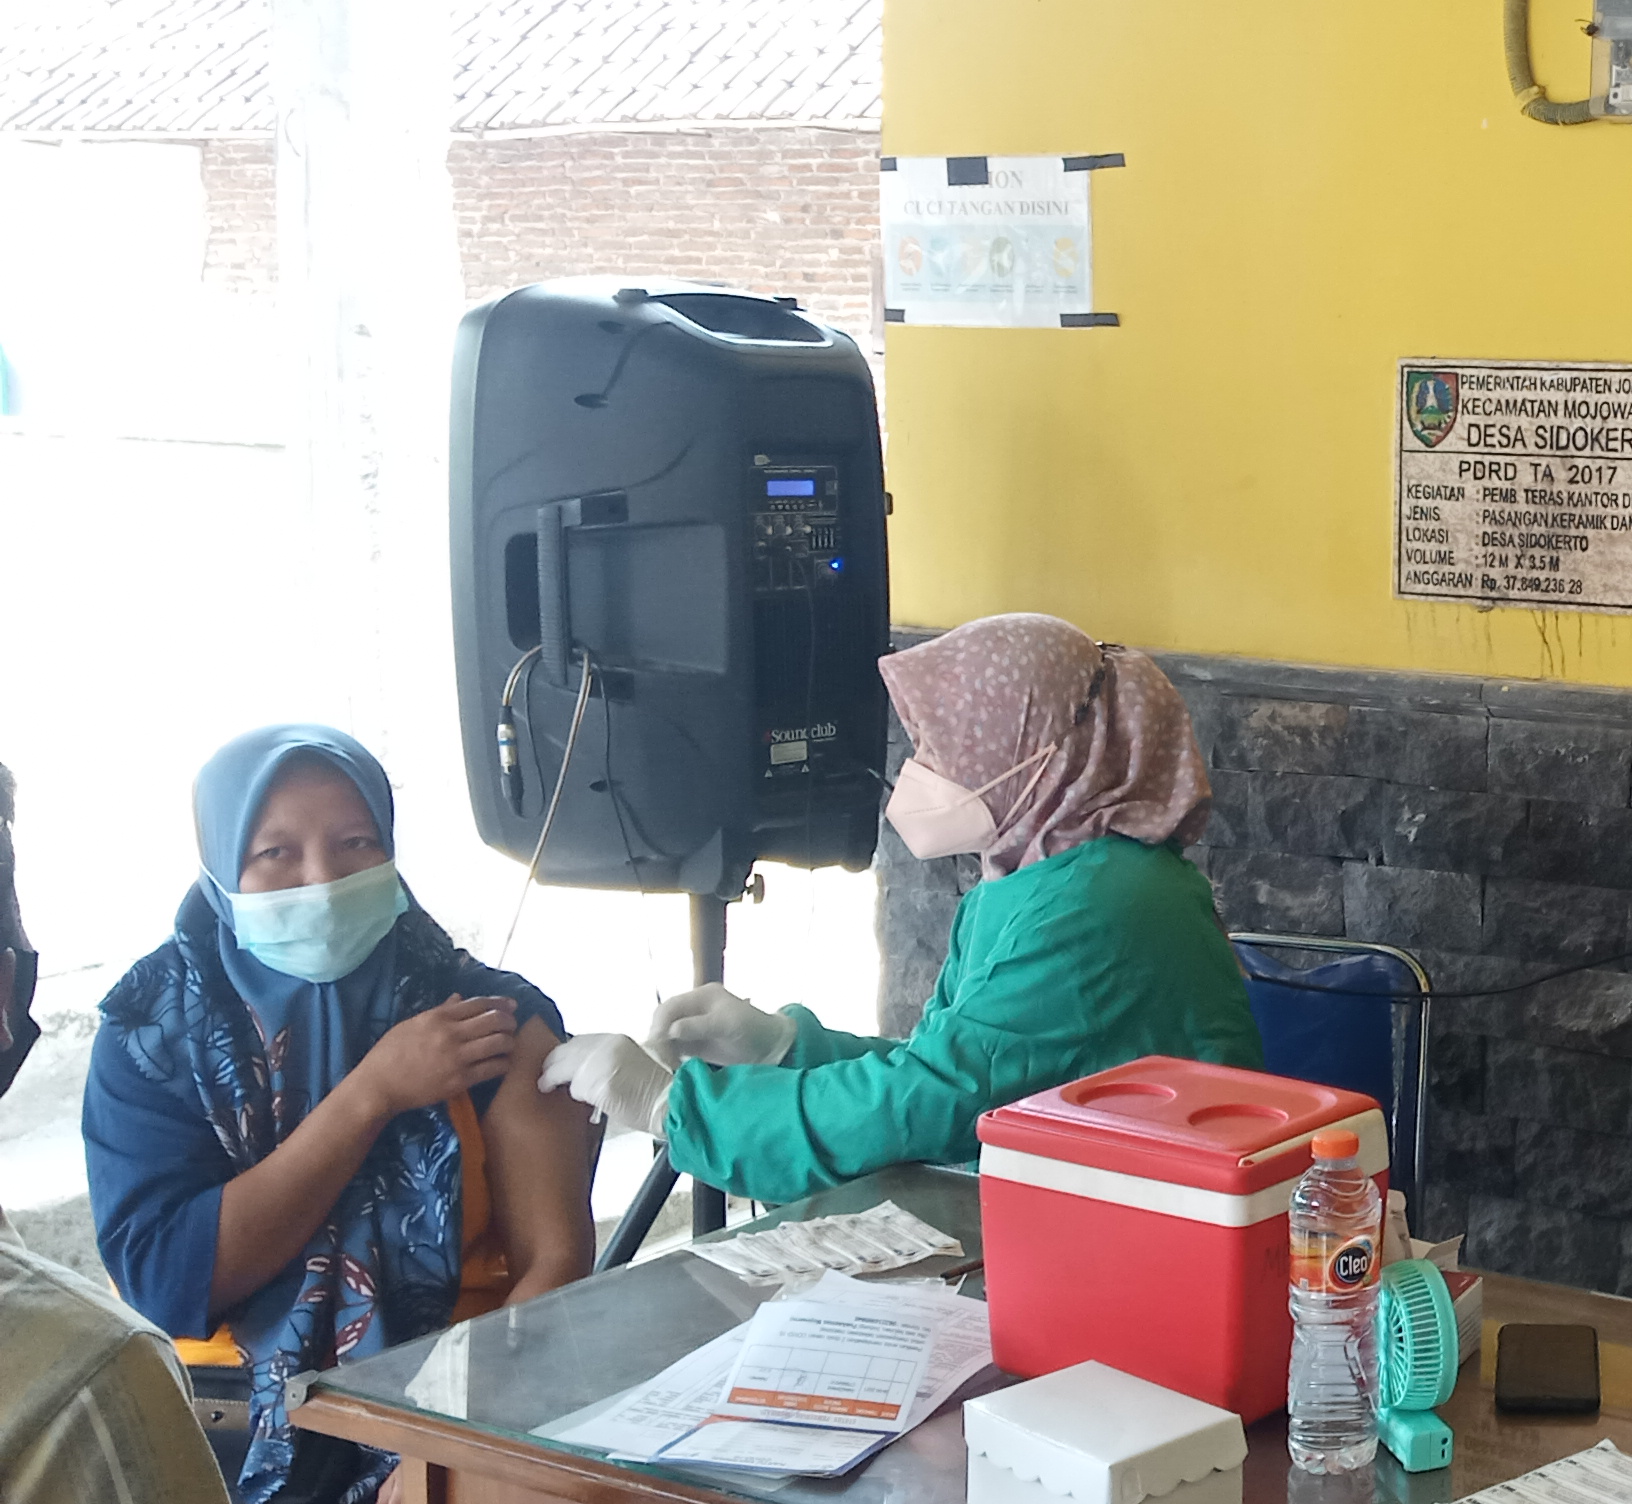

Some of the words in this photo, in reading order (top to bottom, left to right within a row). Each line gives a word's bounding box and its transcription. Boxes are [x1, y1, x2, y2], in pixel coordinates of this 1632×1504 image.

[903, 200, 943, 217] CUCI
[949, 200, 1018, 217] TANGAN
[1019, 200, 1069, 217] DISINI
[1460, 374, 1537, 392] PEMERINTAH
[1540, 376, 1612, 395] KABUPATEN
[1461, 398, 1559, 419] KECAMATAN
[1467, 423, 1527, 449] DESA
[1459, 460, 1517, 481] PDRD
[1529, 462, 1555, 483] TA
[1567, 464, 1618, 486] 2017
[1406, 484, 1465, 502] KEGIATAN
[1523, 488, 1564, 507] TERAS
[1567, 490, 1619, 508] KANTOR
[1405, 505, 1441, 522] JENIS
[1482, 509, 1549, 528] PASANGAN
[1551, 512, 1608, 530] KERAMIK
[1405, 526, 1449, 544] LOKASI
[1482, 531, 1517, 548] DESA
[1518, 532, 1589, 553] SIDOKERTO
[1405, 548, 1456, 566] VOLUME
[1482, 552, 1496, 569] 12
[1499, 553, 1509, 568] M
[1529, 554, 1546, 571] 3.5
[1550, 555, 1560, 572] M
[1405, 570, 1473, 589] ANGGARAN
[1568, 579, 1583, 595] 28
[811, 722, 837, 739] club
[1340, 1255, 1368, 1277] Cleo
